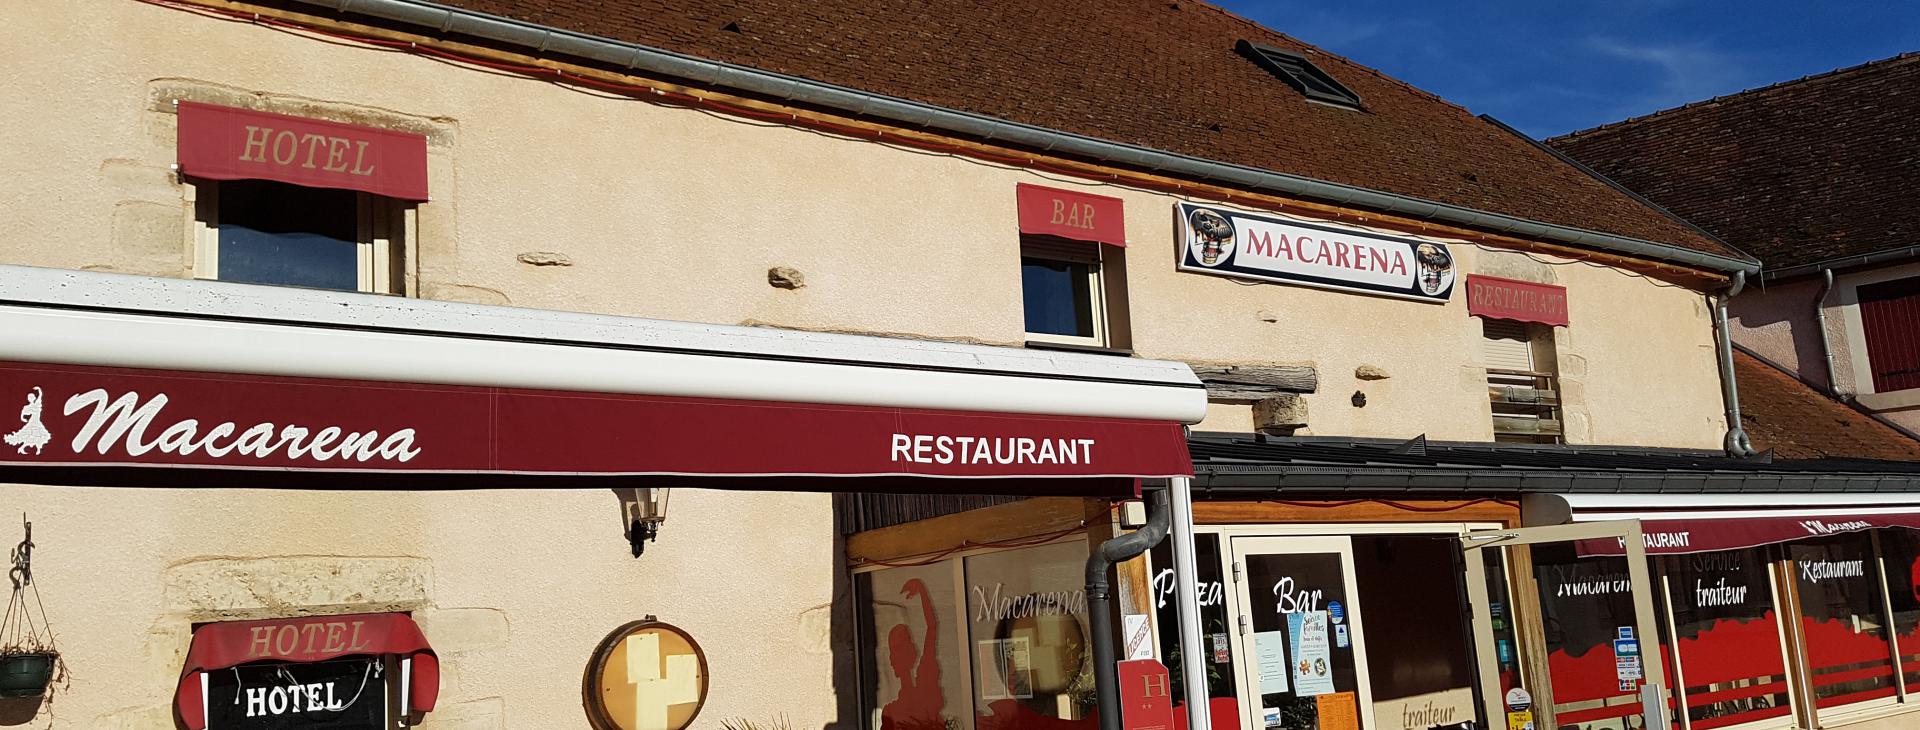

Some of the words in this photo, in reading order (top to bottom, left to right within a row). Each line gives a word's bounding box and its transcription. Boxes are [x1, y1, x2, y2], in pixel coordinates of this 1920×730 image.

[239, 126, 375, 176] HOTEL
[1050, 199, 1095, 229] BAR
[1246, 228, 1407, 276] MACARENA
[1474, 283, 1564, 314] RESTAURANT
[64, 388, 421, 462] Macarena
[891, 433, 1095, 464] RESTAURANT
[1618, 532, 1690, 549] RTAURANT
[1554, 564, 1633, 598] Macaren
[1799, 552, 1864, 584] Restaurant
[972, 582, 1085, 623] Macarena
[1153, 567, 1223, 609] Pza
[1273, 576, 1322, 614] Bar
[1696, 577, 1747, 608] traiteur
[248, 621, 370, 657] HOTEL
[246, 682, 342, 717] HOTEL
[1141, 673, 1168, 698] H
[1403, 700, 1456, 728] traiteur
